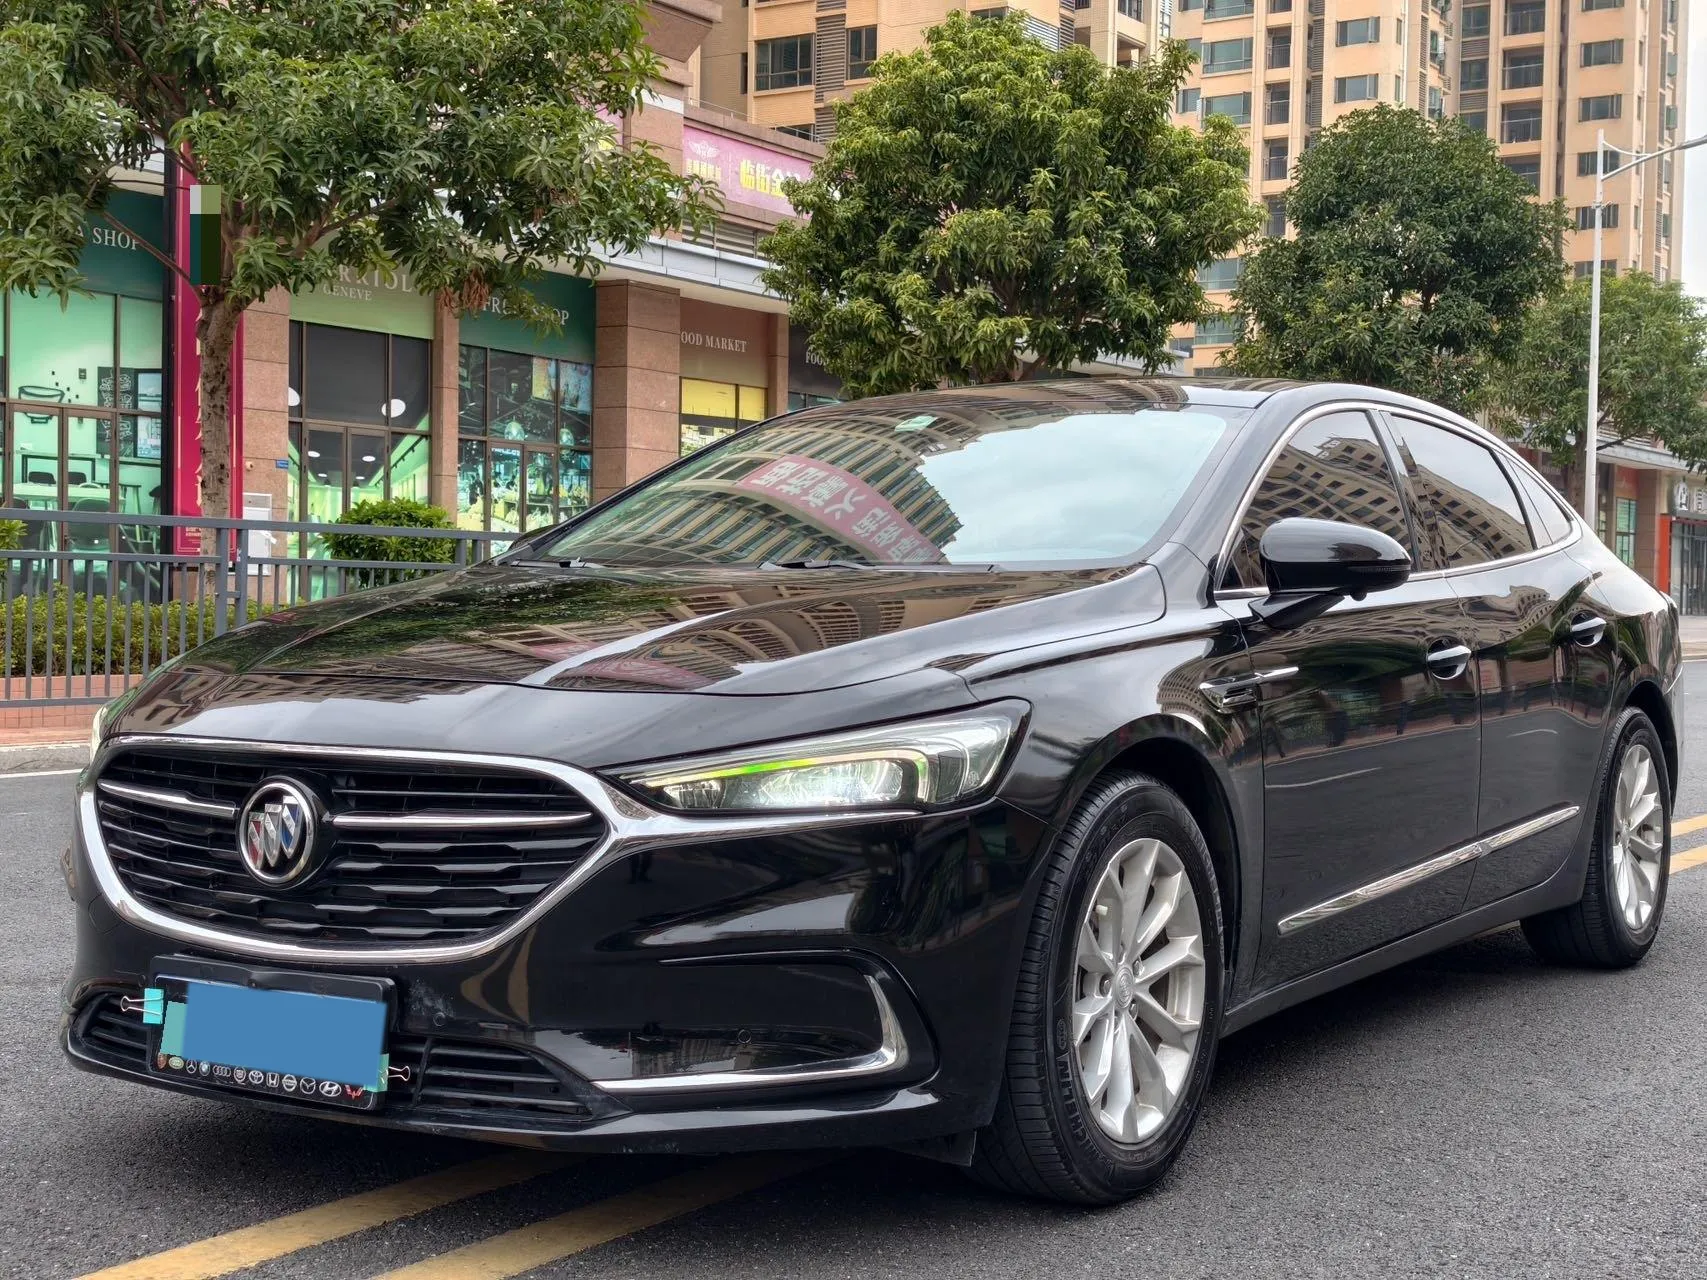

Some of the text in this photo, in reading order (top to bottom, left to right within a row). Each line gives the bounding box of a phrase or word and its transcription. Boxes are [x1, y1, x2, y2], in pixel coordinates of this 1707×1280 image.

[323, 284, 372, 301] GENEVE
[680, 331, 747, 352] OOD MARKET
[805, 351, 825, 366] FOO
